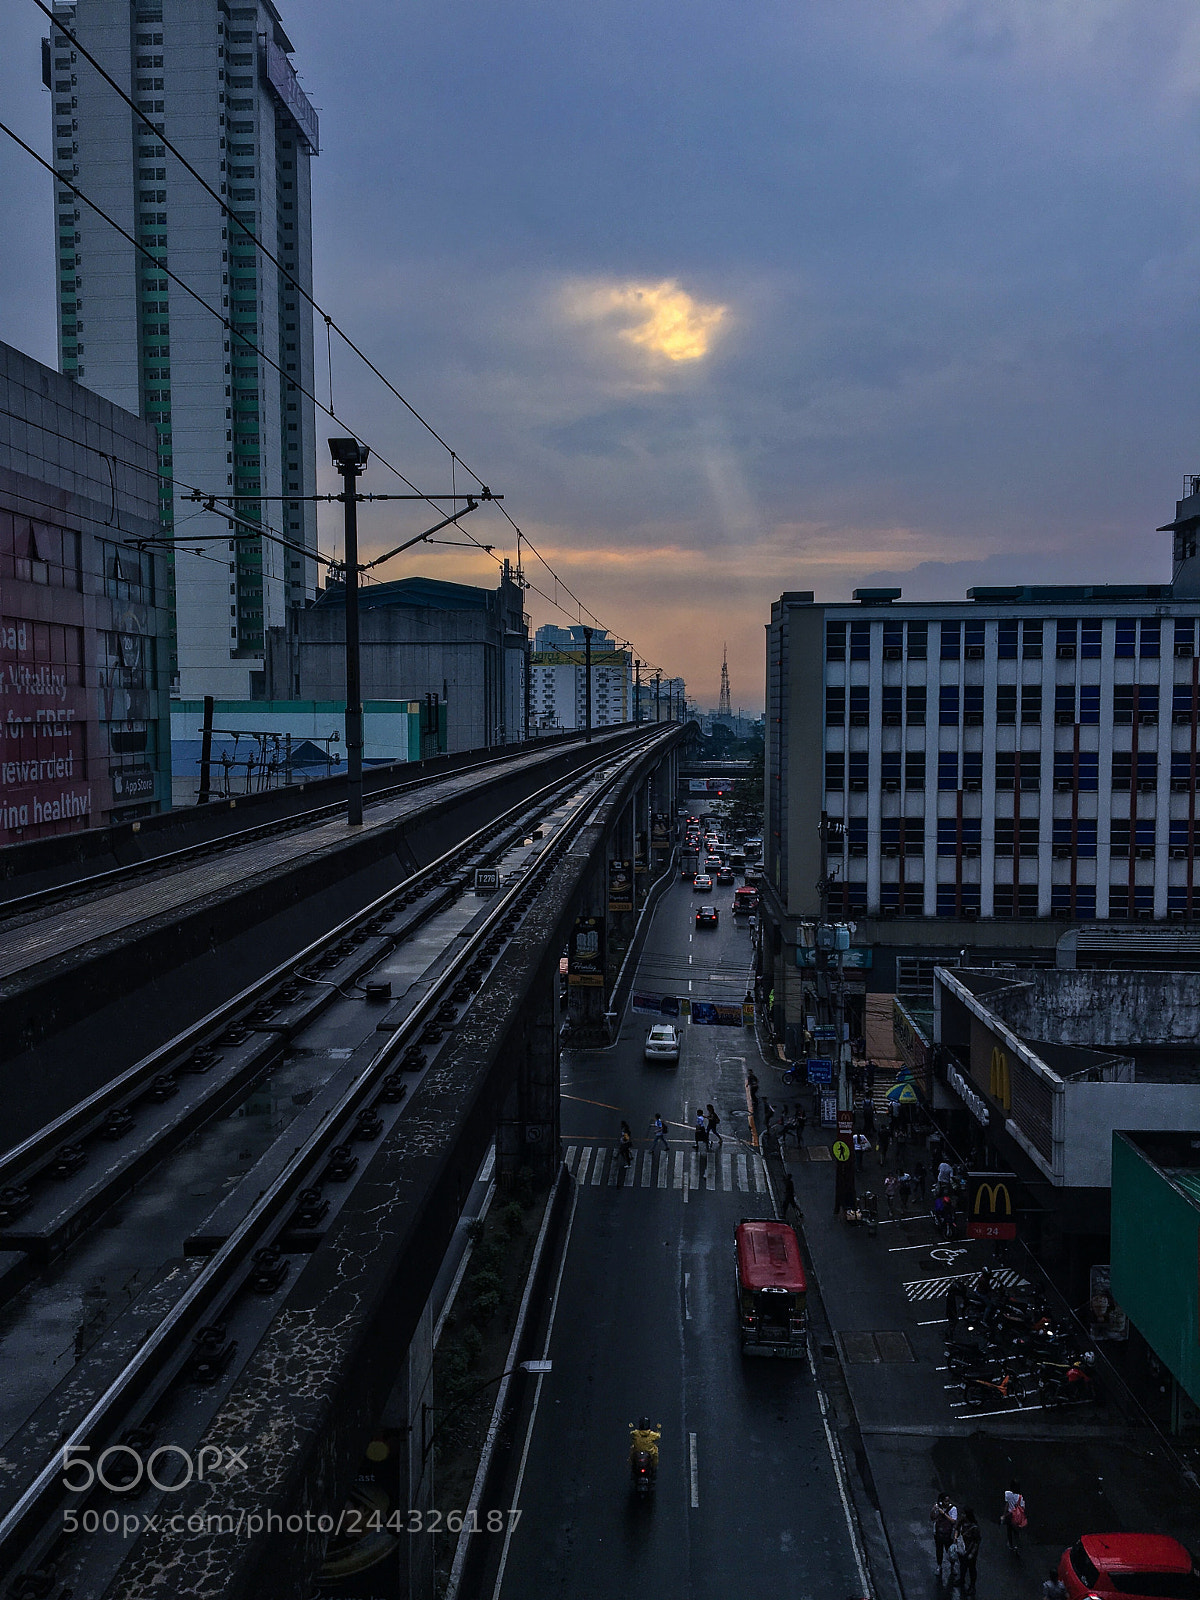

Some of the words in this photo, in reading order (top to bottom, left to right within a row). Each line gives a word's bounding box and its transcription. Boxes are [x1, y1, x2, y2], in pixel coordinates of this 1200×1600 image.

[9, 665, 67, 702] Vitality
[5, 708, 32, 739] for
[33, 708, 75, 738] FREE
[1, 749, 74, 785] rewarded
[125, 779, 137, 796] App
[137, 777, 153, 792] Store
[33, 788, 92, 824] healthy!
[986, 1227, 999, 1236] 24
